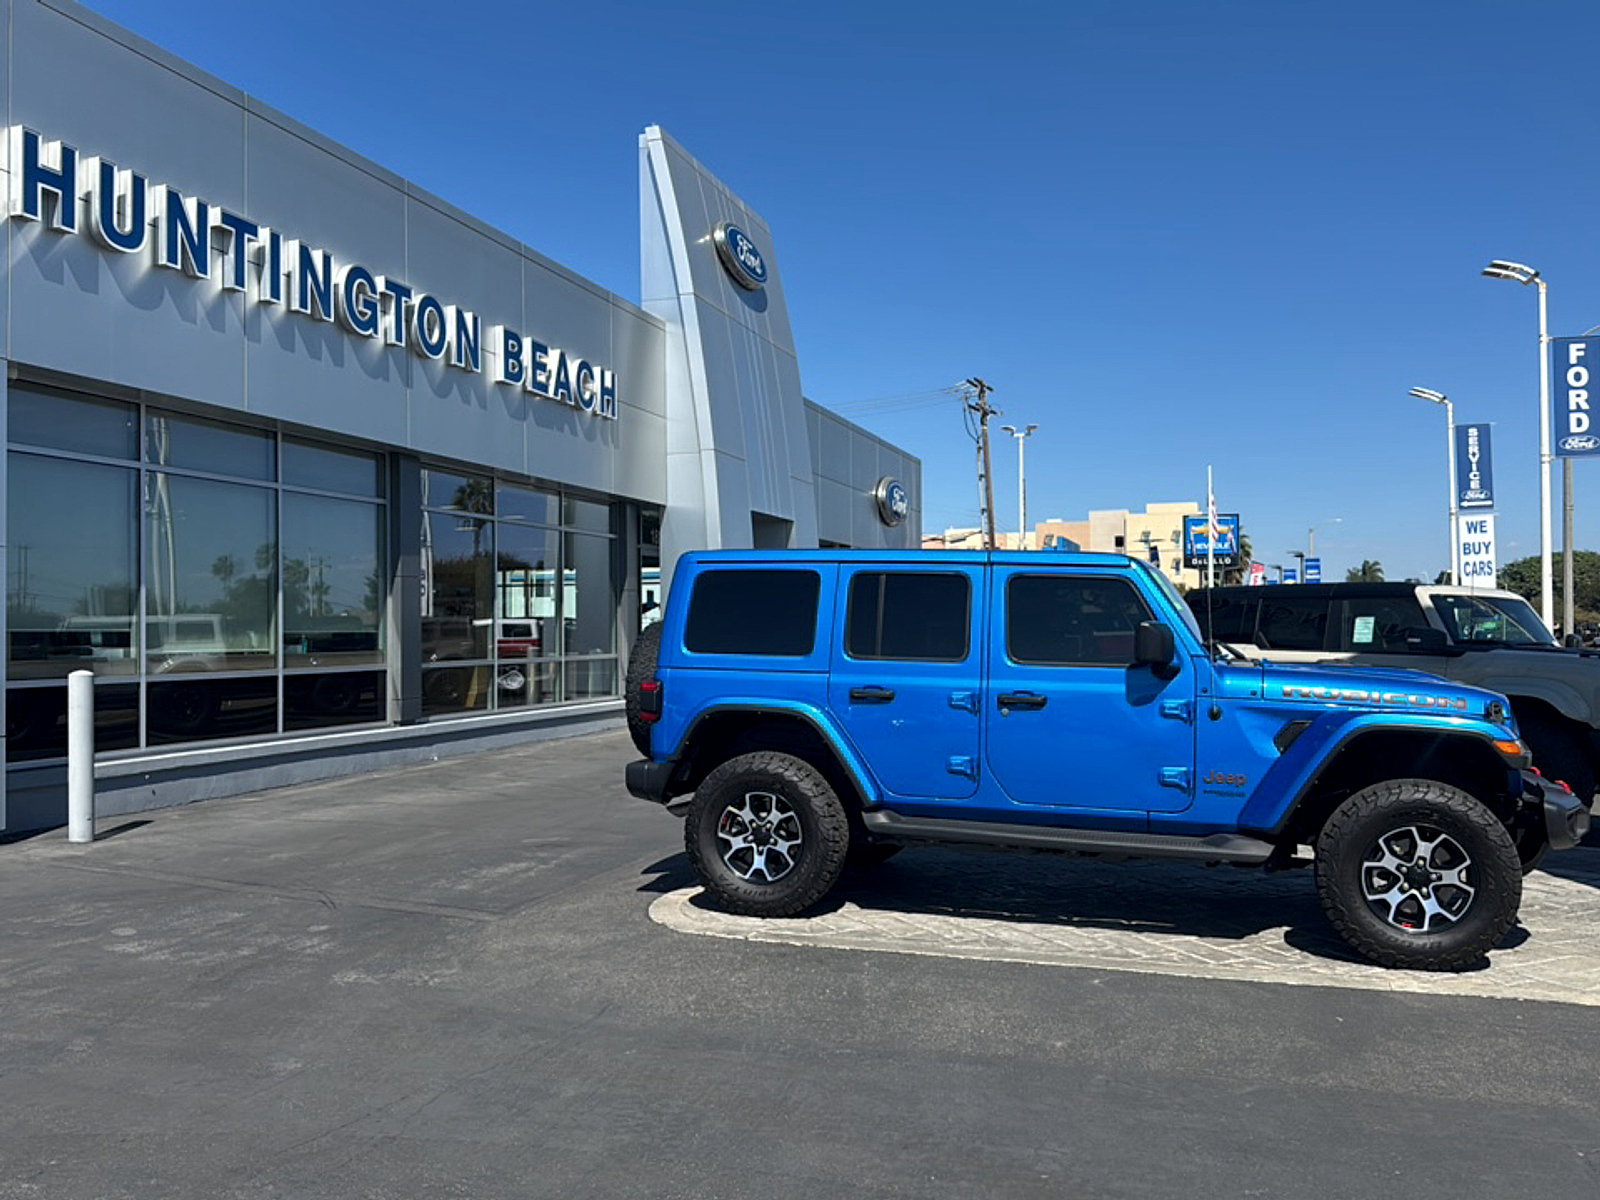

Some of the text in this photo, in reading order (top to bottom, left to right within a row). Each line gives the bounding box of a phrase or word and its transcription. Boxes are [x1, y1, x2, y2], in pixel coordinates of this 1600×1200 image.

[736, 233, 762, 275] Ford
[12, 124, 618, 419] HUNTINGTON BEACH
[1566, 343, 1590, 433] FORD
[1563, 436, 1597, 450] Ford
[1468, 427, 1480, 490] SERVICE
[891, 487, 908, 515] Ford
[1466, 520, 1487, 534] WE
[1463, 541, 1491, 555] BUY
[1191, 557, 1232, 565] DeLLLO
[1463, 561, 1493, 576] CARS
[1283, 685, 1467, 711] RUBICON
[1203, 769, 1247, 787] Jeep
